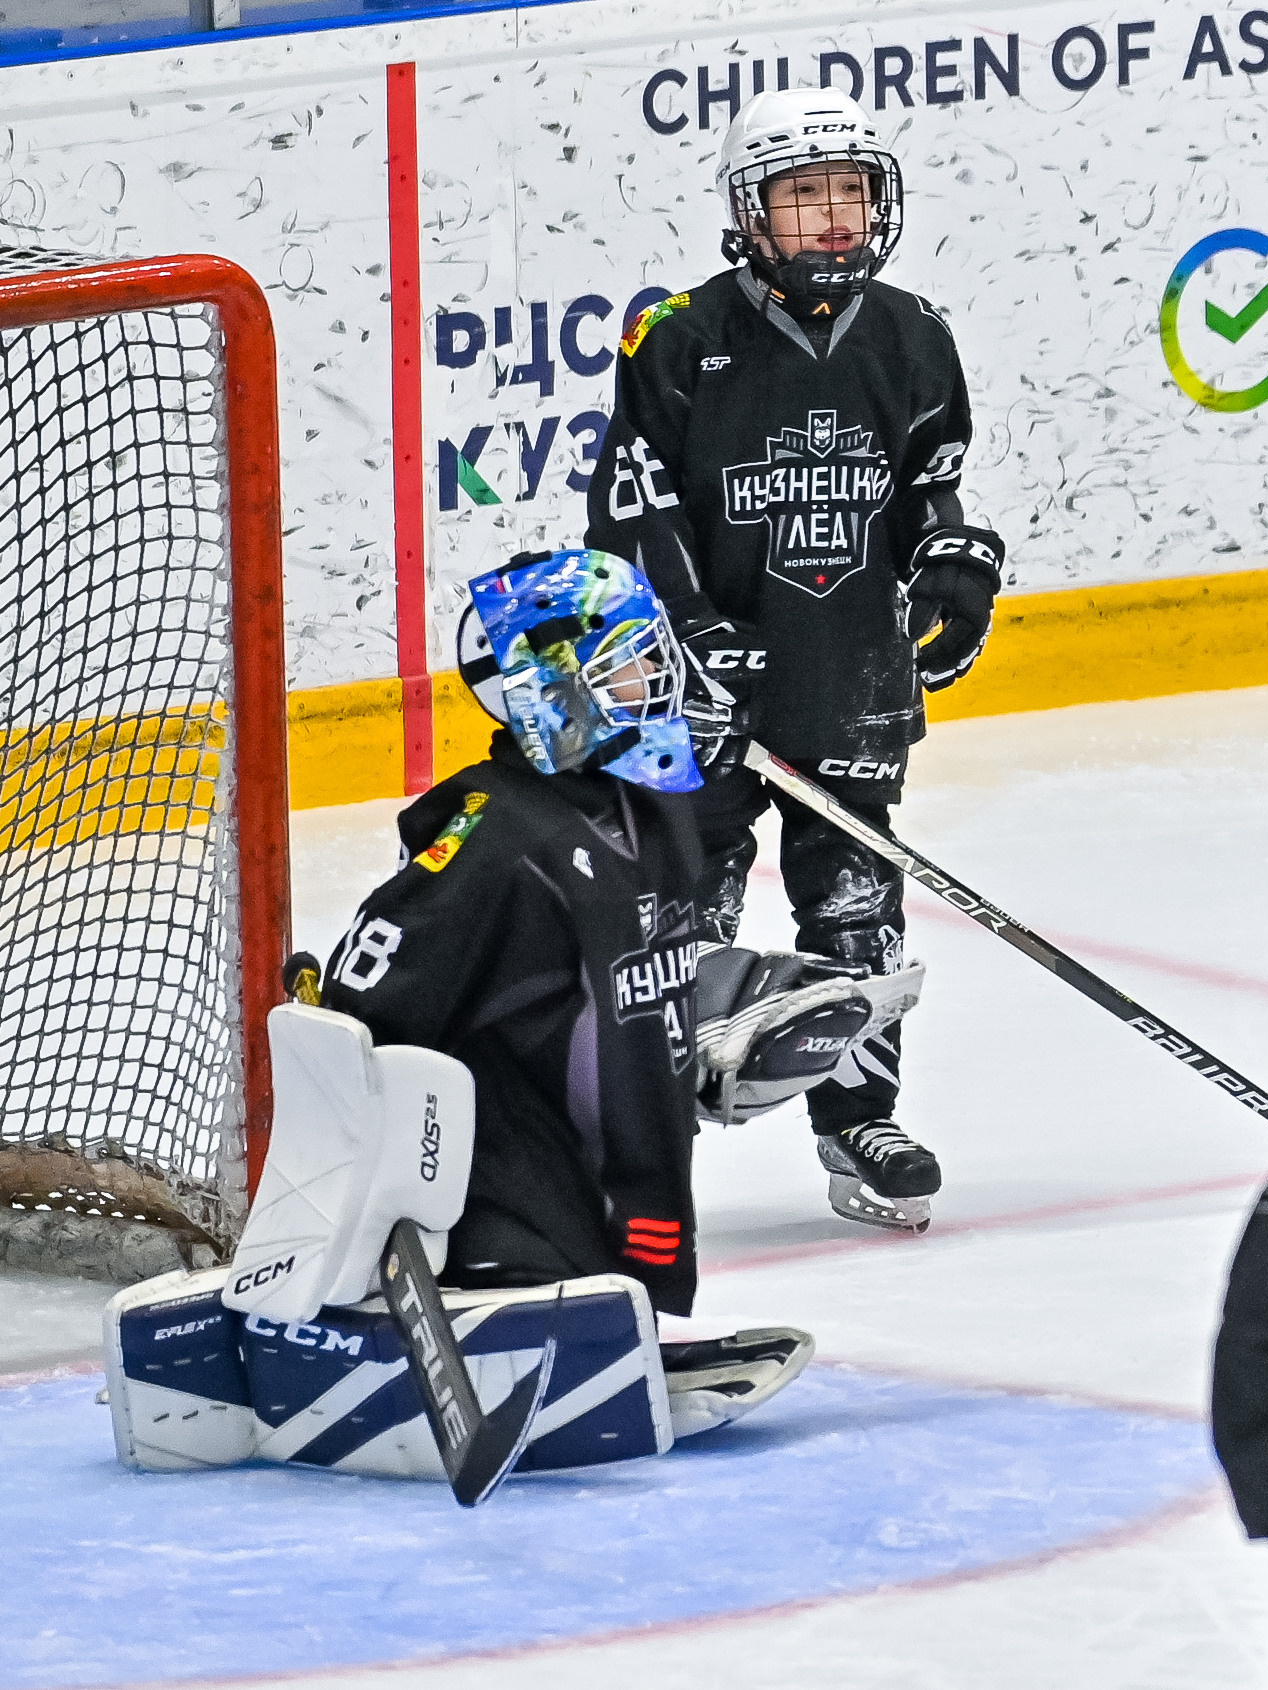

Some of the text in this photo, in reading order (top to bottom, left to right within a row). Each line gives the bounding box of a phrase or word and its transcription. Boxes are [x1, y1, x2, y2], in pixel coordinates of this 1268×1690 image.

[1051, 21, 1155, 92] OF
[802, 123, 856, 135] CCM
[787, 504, 849, 550] ЛЁД
[818, 758, 900, 780] CCM
[234, 1255, 295, 1295] CCM
[245, 1313, 364, 1356] CCM
[400, 1273, 468, 1451] TRUE
